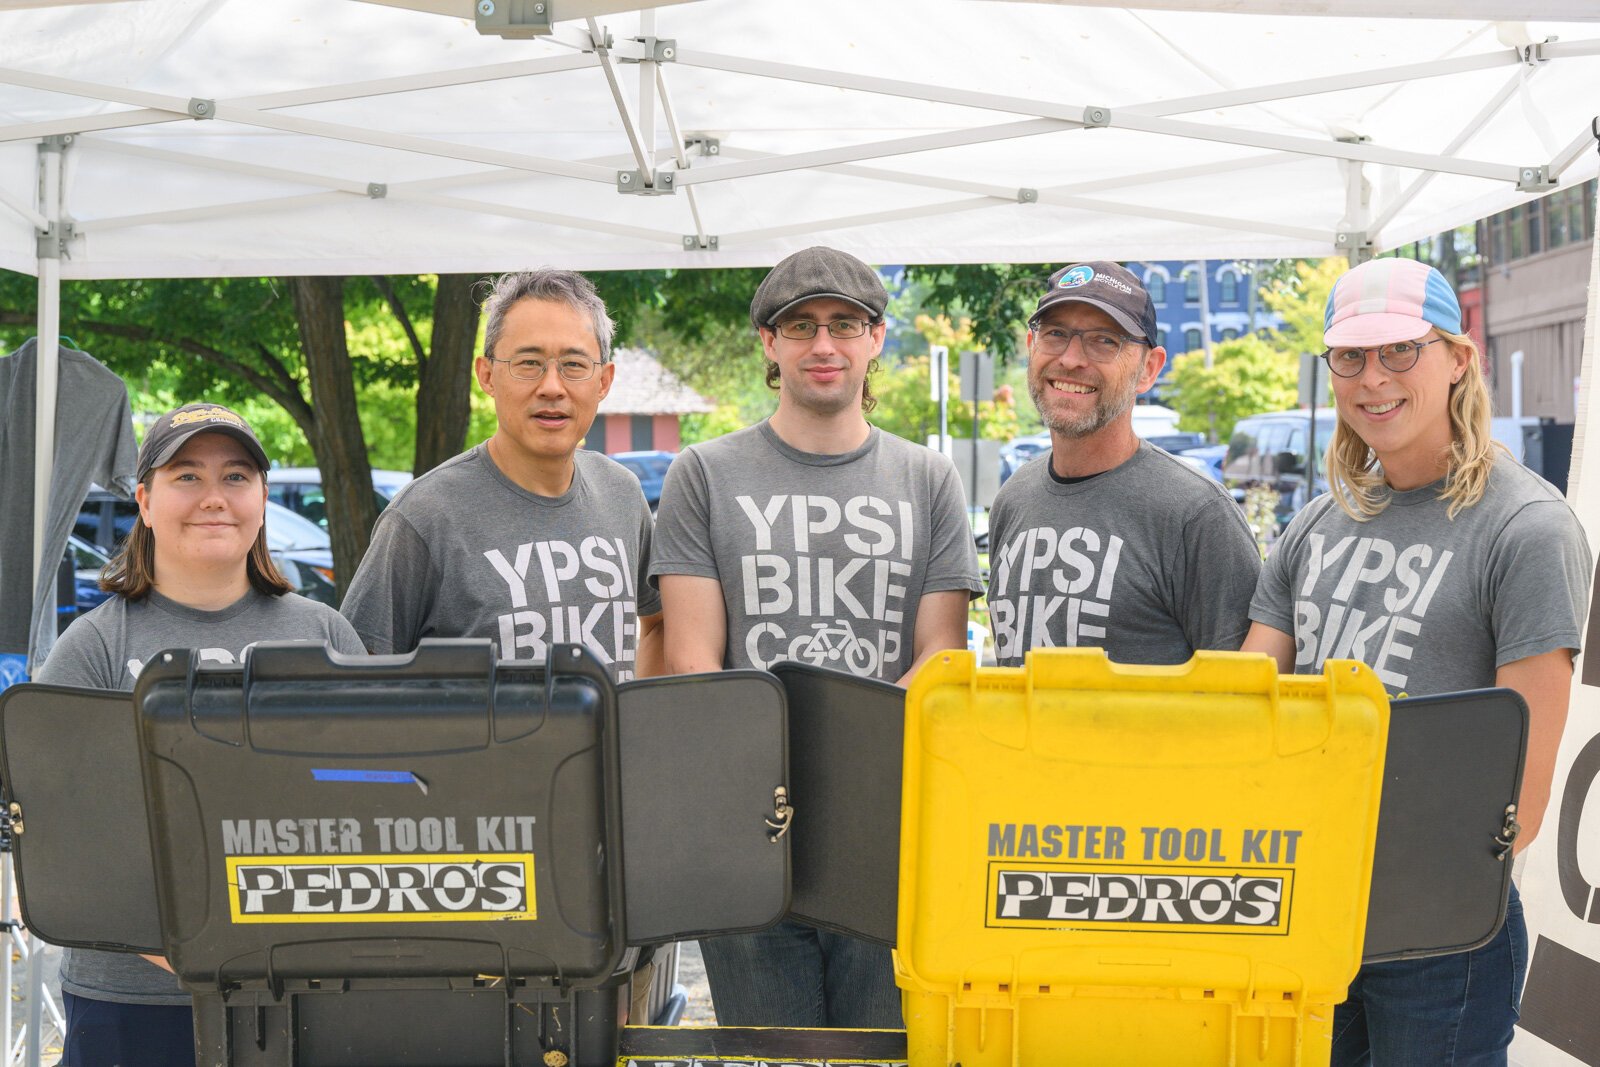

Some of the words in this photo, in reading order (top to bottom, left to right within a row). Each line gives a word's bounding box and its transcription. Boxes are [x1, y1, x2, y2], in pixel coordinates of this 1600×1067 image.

[1094, 277, 1119, 289] BICYCLE
[1095, 273, 1132, 292] MICHIGAN
[735, 494, 914, 560] YPSI
[483, 535, 635, 608] YPSI
[742, 554, 912, 623] BIKE
[998, 526, 1124, 600] YPSI
[1301, 533, 1454, 618] YPSI
[498, 600, 635, 664] BIKE
[990, 595, 1110, 659] BIKE
[1294, 601, 1422, 689] BIKE
[221, 817, 363, 854] MASTER
[373, 816, 464, 852] TOOL
[476, 816, 536, 851] KIT
[987, 823, 1127, 860] MASTER
[1140, 827, 1227, 862] TOOL
[1241, 829, 1303, 864] KIT
[238, 860, 526, 913] PEDRO'S
[1000, 872, 1280, 926] PEDRO'S
